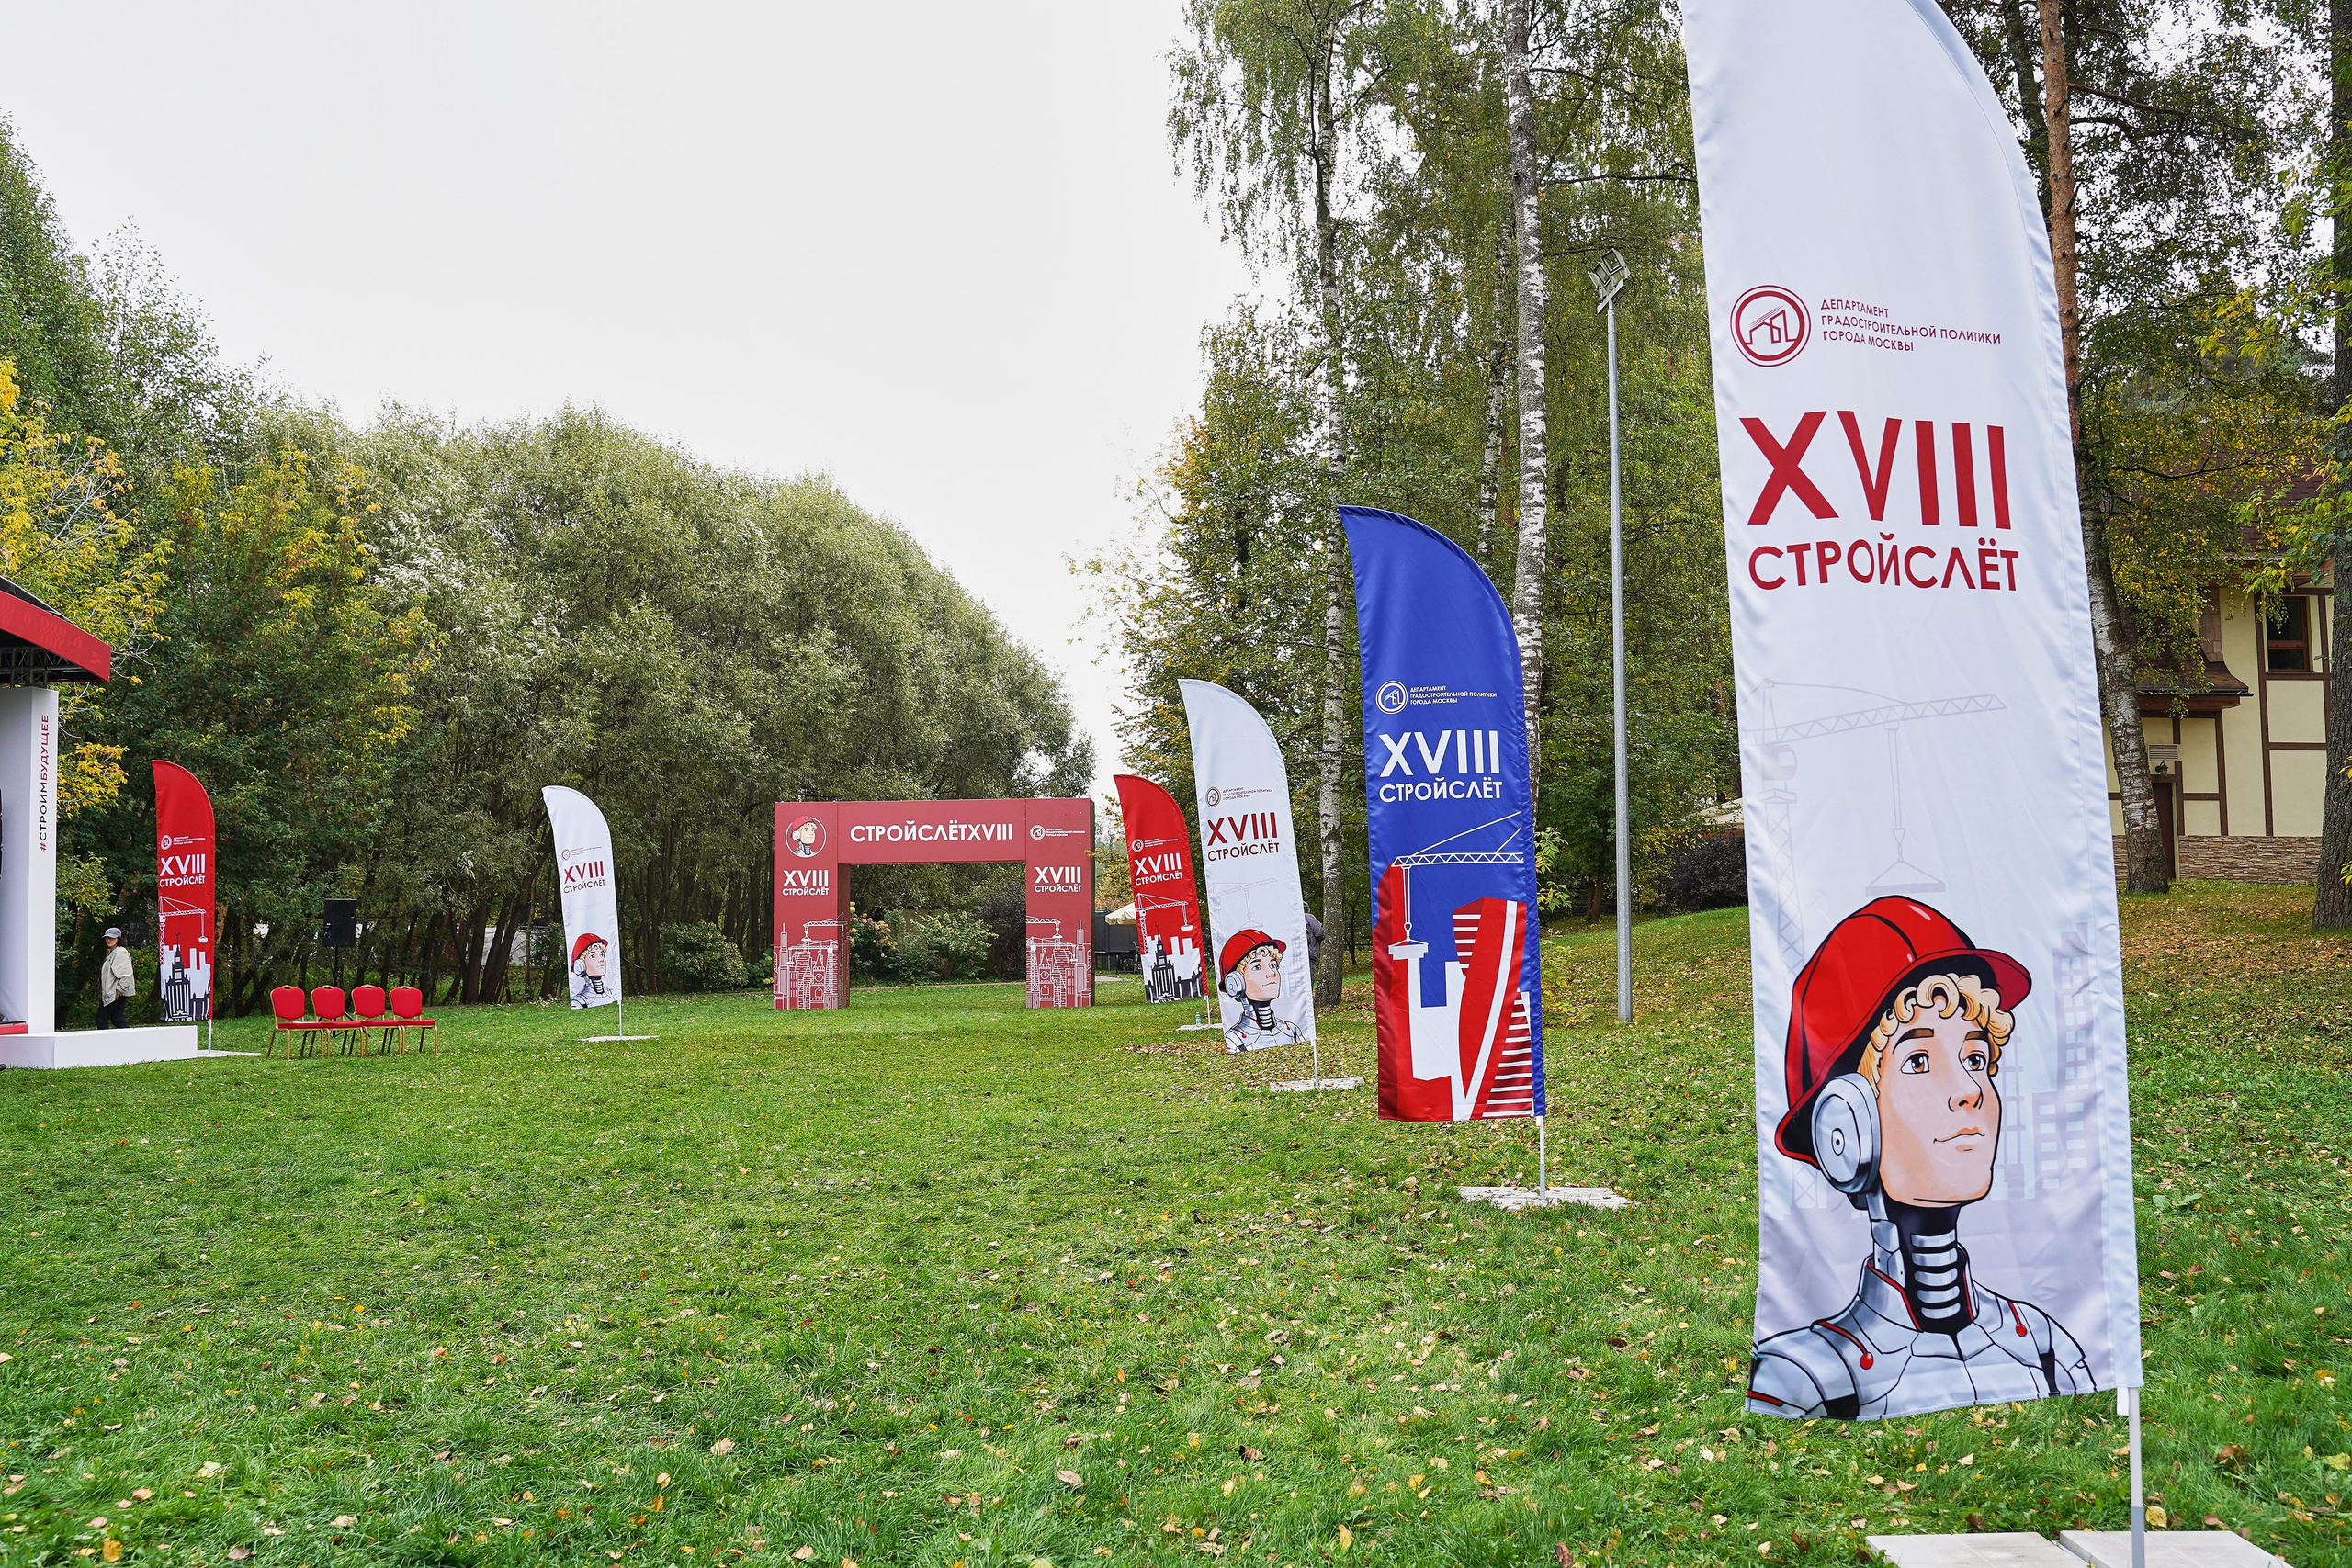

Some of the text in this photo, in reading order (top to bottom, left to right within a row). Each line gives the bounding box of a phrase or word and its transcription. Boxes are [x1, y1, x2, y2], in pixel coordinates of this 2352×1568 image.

[1820, 299, 1889, 319] ДЕПАРТАМЕНТ
[1821, 315, 2001, 344] ГРАДОСТРОИТЕЛЬНОЙ ПОЛИТИКИ
[1823, 330, 1914, 351] ГОРОДА МОСКВЫ
[1738, 410, 2012, 530] XVIII
[1747, 531, 2019, 592] СТРОЙСЛЁТ
[1378, 729, 1500, 778] XVIII
[40, 714, 50, 852] #СТРОИМБУДУЩЕЕ
[1379, 776, 1503, 803] СТРОЙСЛЁТ
[1207, 812, 1278, 847] XVIII
[1207, 840, 1280, 862] СТРОЙСЛЁТ
[159, 853, 206, 877] XVIII
[563, 860, 605, 885] XVIII
[1035, 866, 1081, 884] XVIII
[1134, 852, 1182, 877] XVIII
[159, 874, 206, 887] СТРОЙСЛЁТ
[563, 878, 605, 894] СТРОЙСЛЁТ
[783, 870, 830, 886] XVIII
[1034, 883, 1082, 893] СТРОЙСЛЁТ
[1135, 870, 1183, 886] СТРОЙСЛЁТ
[782, 886, 830, 896] СТРОЙСЛЁТ
